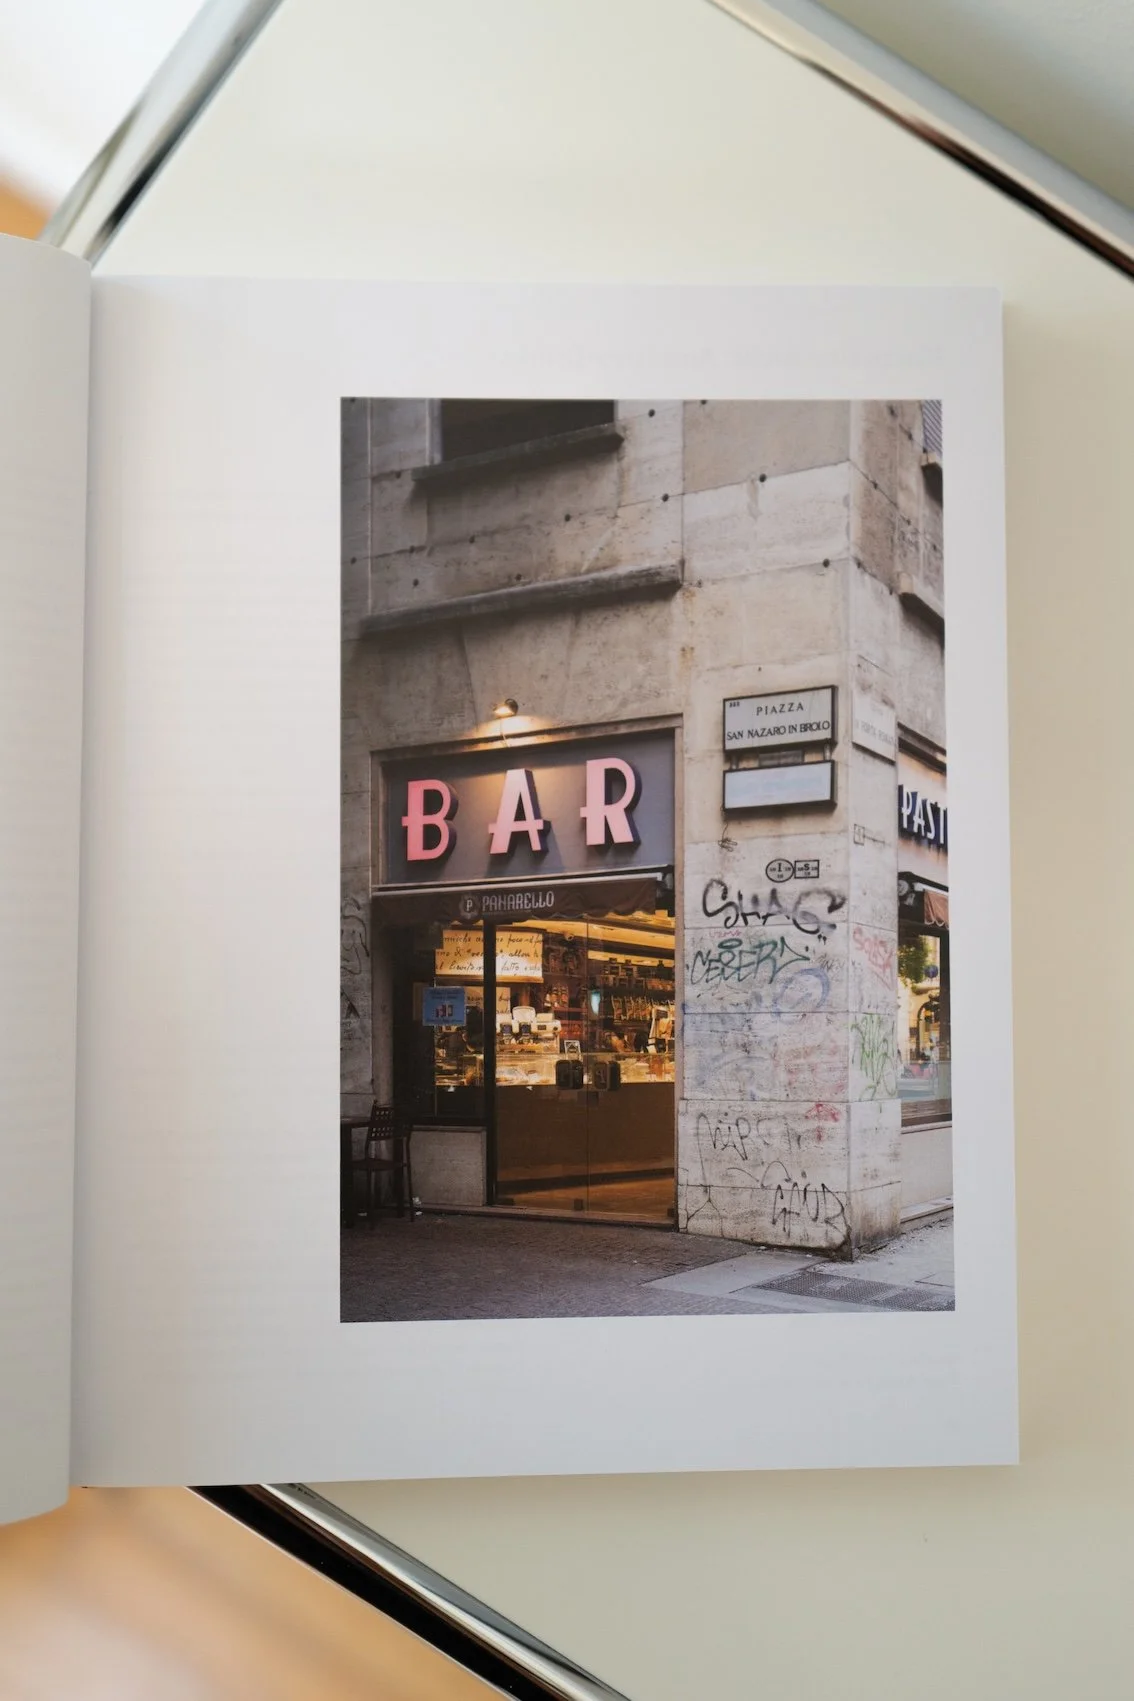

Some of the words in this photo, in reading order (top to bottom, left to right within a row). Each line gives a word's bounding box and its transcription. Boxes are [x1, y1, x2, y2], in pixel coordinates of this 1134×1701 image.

[755, 702, 805, 716] PIAZZA
[726, 731, 744, 741] SAN
[747, 725, 787, 738] NAZARO
[788, 723, 798, 734] IN
[799, 720, 831, 733] BROLO
[401, 757, 638, 862] BAR
